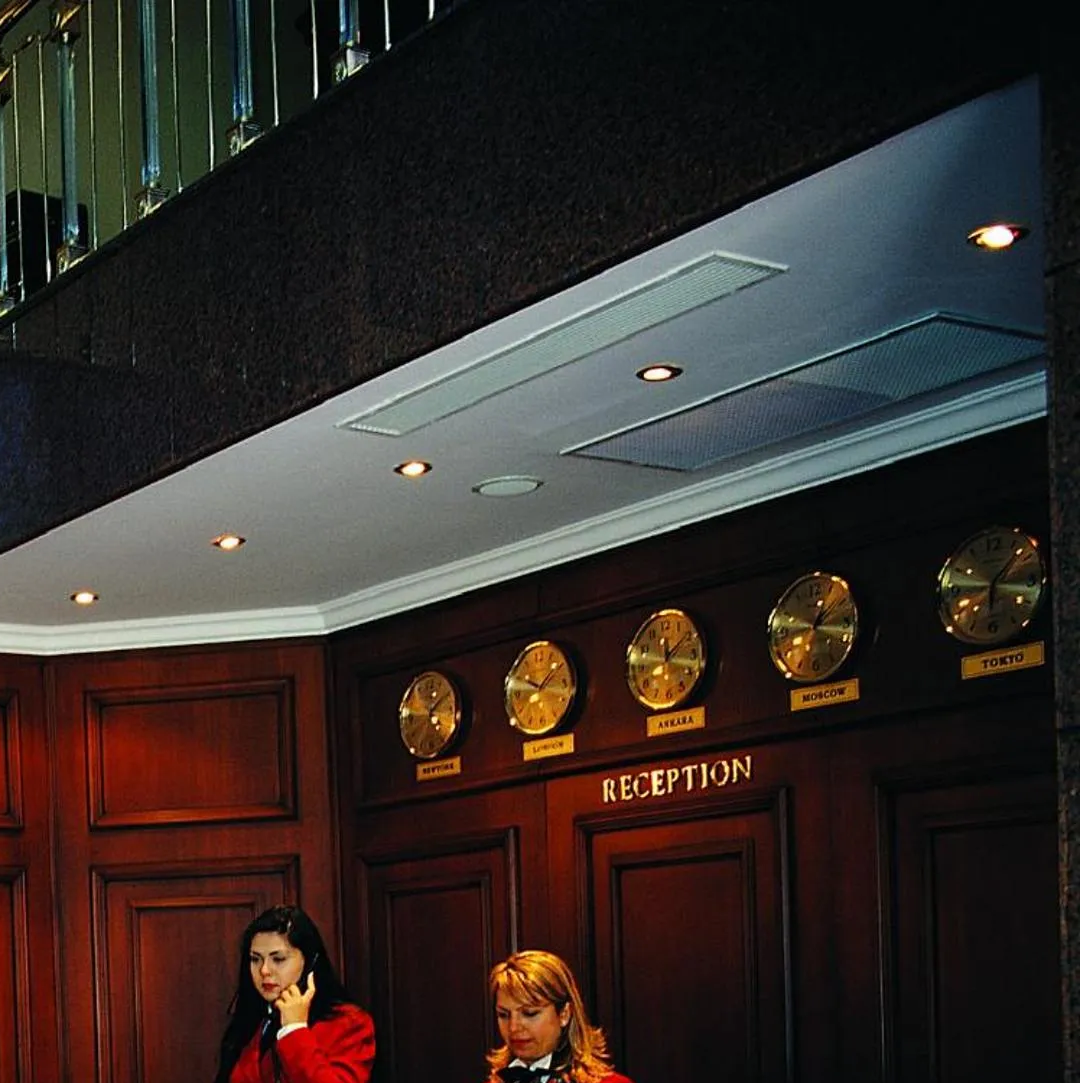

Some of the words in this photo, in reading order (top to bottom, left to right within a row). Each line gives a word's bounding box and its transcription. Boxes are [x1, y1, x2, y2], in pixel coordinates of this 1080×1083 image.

[661, 620, 671, 632] 12
[981, 653, 1023, 669] TOKYO
[802, 687, 847, 704] MOSCOW
[658, 715, 695, 730] ANKARA
[602, 755, 752, 803] RECEPTION
